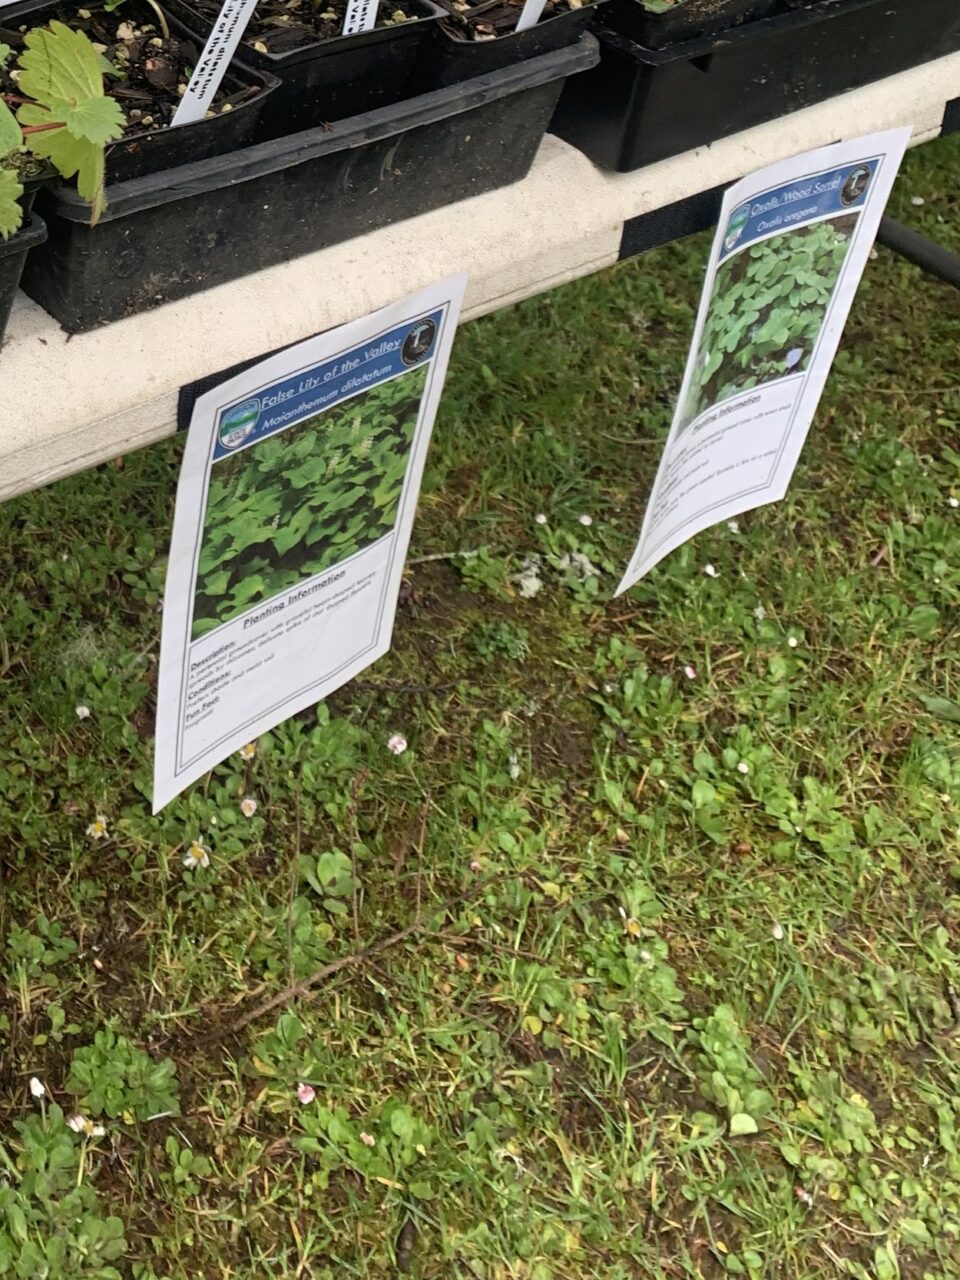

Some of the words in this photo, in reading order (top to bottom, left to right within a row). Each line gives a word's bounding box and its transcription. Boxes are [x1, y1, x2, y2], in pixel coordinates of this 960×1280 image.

[206, 36, 221, 55] the
[216, 21, 226, 34] of
[261, 387, 295, 409] False
[299, 376, 321, 394] Lily
[323, 365, 338, 381] of
[341, 357, 360, 373] the
[364, 337, 402, 361] Valley
[261, 389, 338, 431] Maianthemum
[341, 364, 393, 393] dilatatum
[244, 602, 284, 630] Planting
[288, 570, 346, 606] Information
